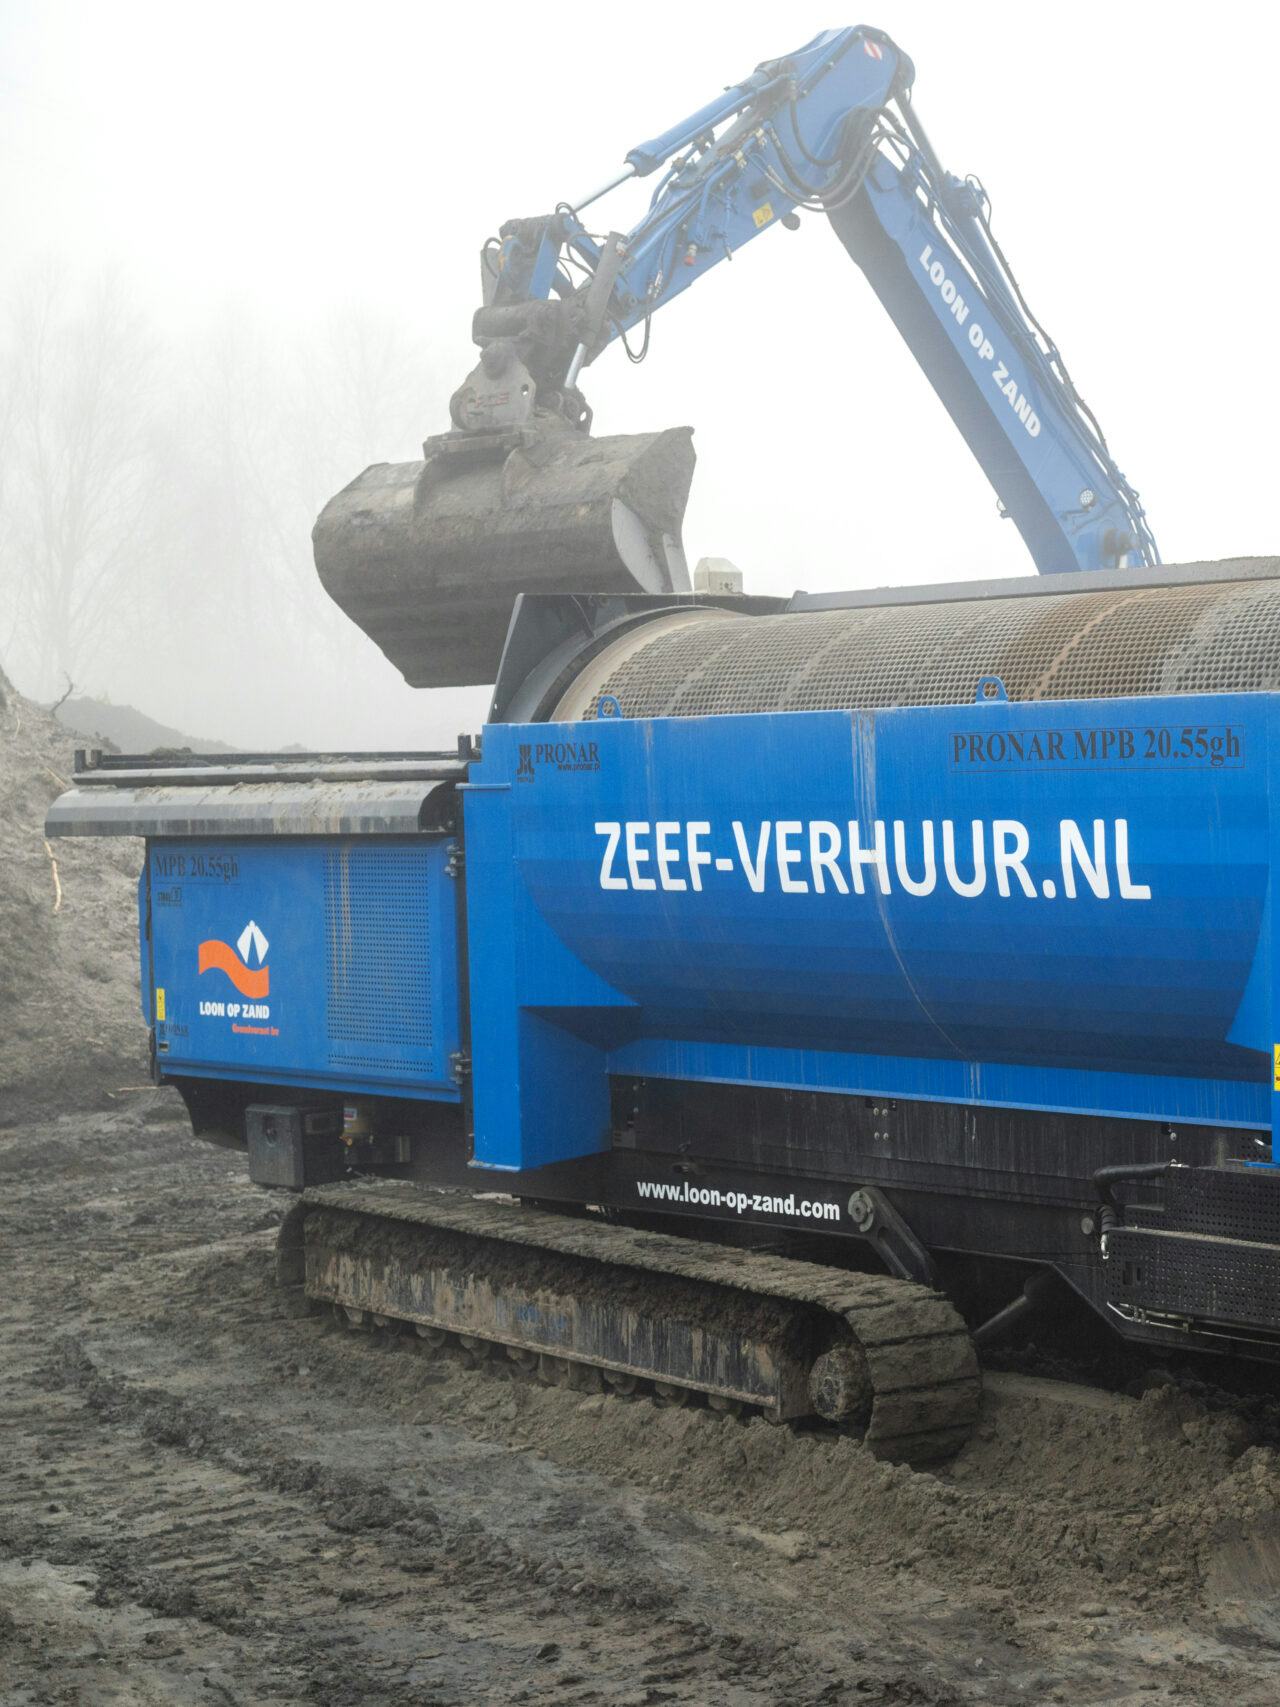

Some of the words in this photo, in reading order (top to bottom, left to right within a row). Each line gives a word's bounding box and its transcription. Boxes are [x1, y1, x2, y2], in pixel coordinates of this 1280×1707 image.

[919, 245, 970, 326] LOON
[968, 323, 995, 361] OP
[992, 360, 1041, 438] ZAND
[535, 742, 601, 764] PRONAR
[952, 731, 1067, 764] PRONAR
[1073, 730, 1135, 761] MPB
[1143, 728, 1241, 767] 20.55gh
[156, 855, 186, 878] MPB
[191, 855, 239, 885] 20.55gh
[594, 818, 1152, 900] ZEEF-VERHUUR.NL
[199, 1001, 225, 1017] LOON
[227, 1003, 241, 1018] OP
[242, 1004, 270, 1019] ZAND
[636, 1181, 841, 1221] www.loon-op-zand.com
